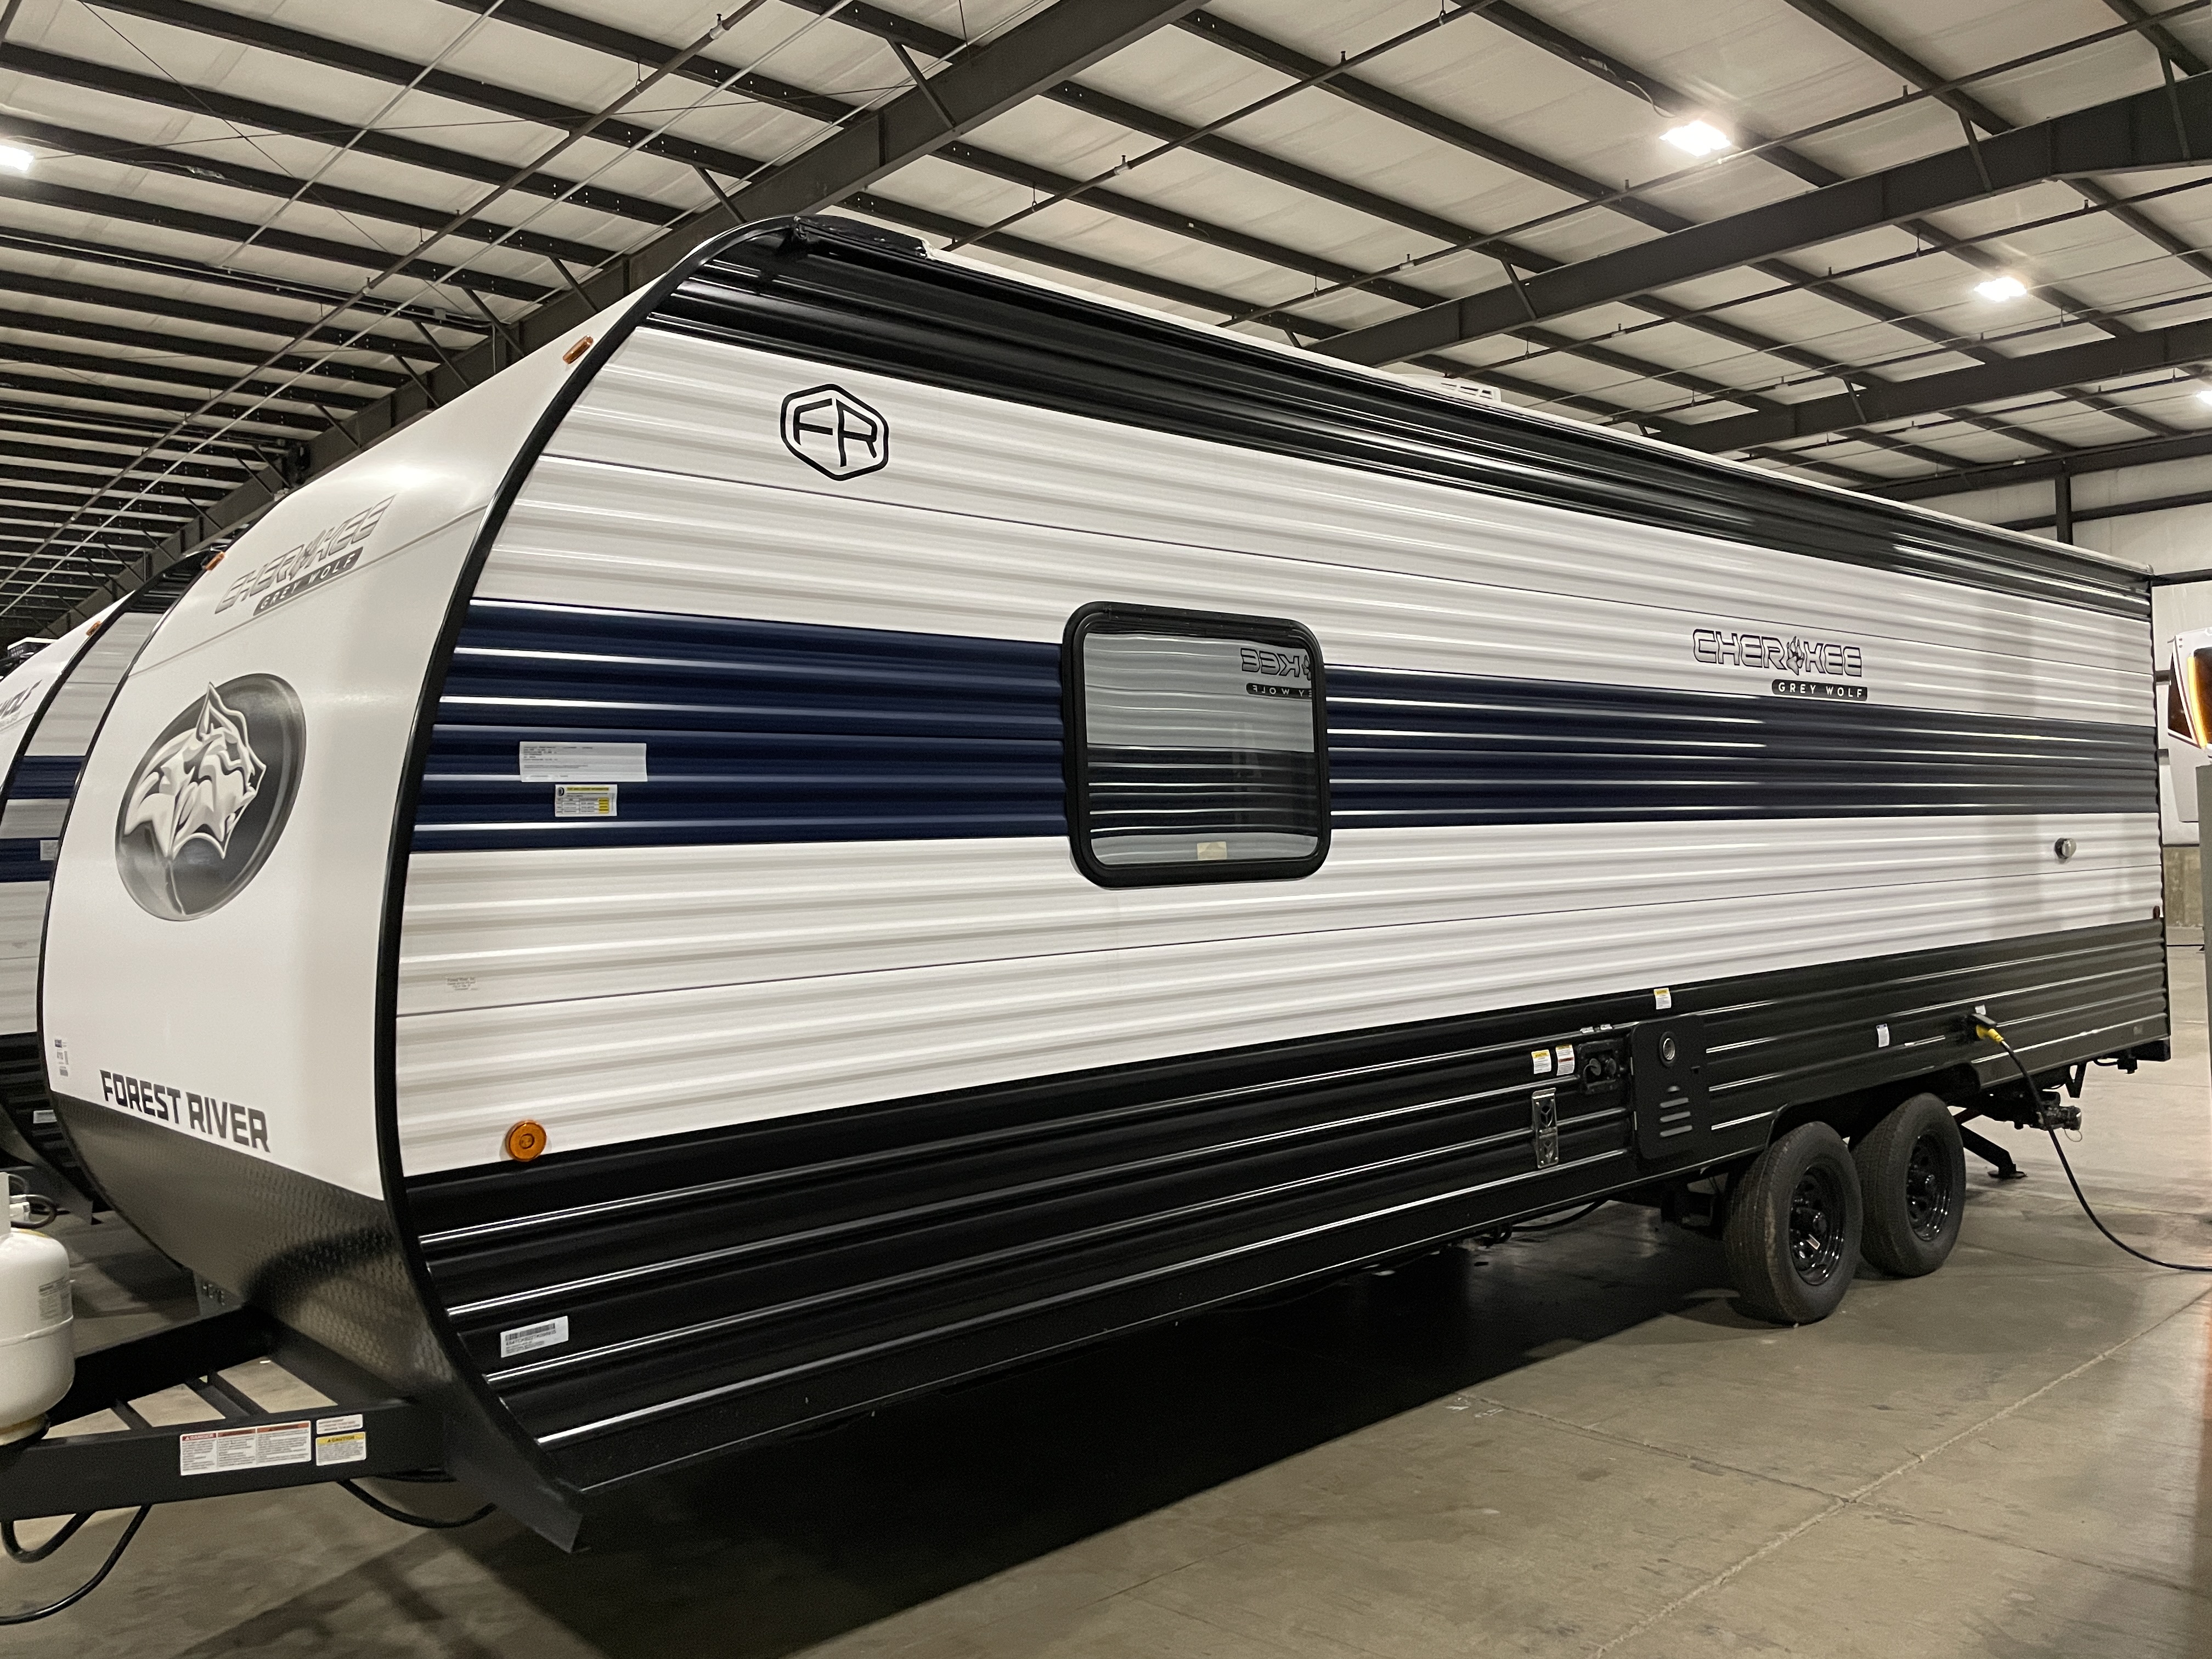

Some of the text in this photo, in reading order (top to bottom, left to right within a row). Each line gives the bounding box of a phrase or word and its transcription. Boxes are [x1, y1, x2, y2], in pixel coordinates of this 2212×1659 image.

[260, 552, 356, 610] GREY WOLF
[1778, 682, 1863, 698] GREY WOLF
[99, 1069, 271, 1154] FOREST RIVER
